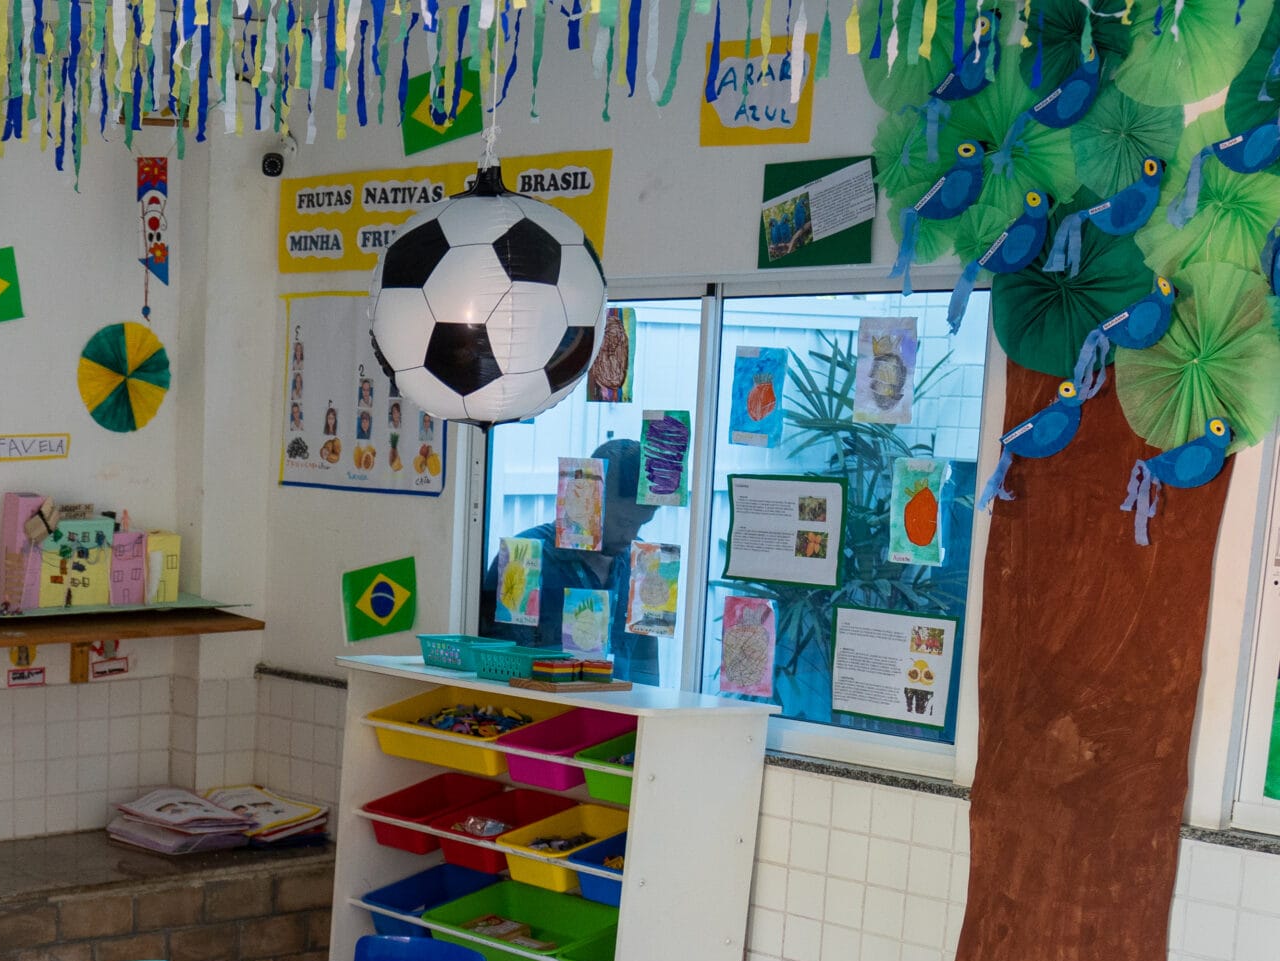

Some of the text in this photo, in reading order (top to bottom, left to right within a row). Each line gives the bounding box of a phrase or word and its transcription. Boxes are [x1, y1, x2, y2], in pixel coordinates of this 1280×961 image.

[717, 54, 806, 96] ARAR
[734, 103, 791, 124] AZUL
[297, 189, 352, 209] FRUTAS
[363, 185, 444, 204] NATIVAS
[520, 171, 591, 192] BRASIL
[289, 234, 342, 251] MINHA
